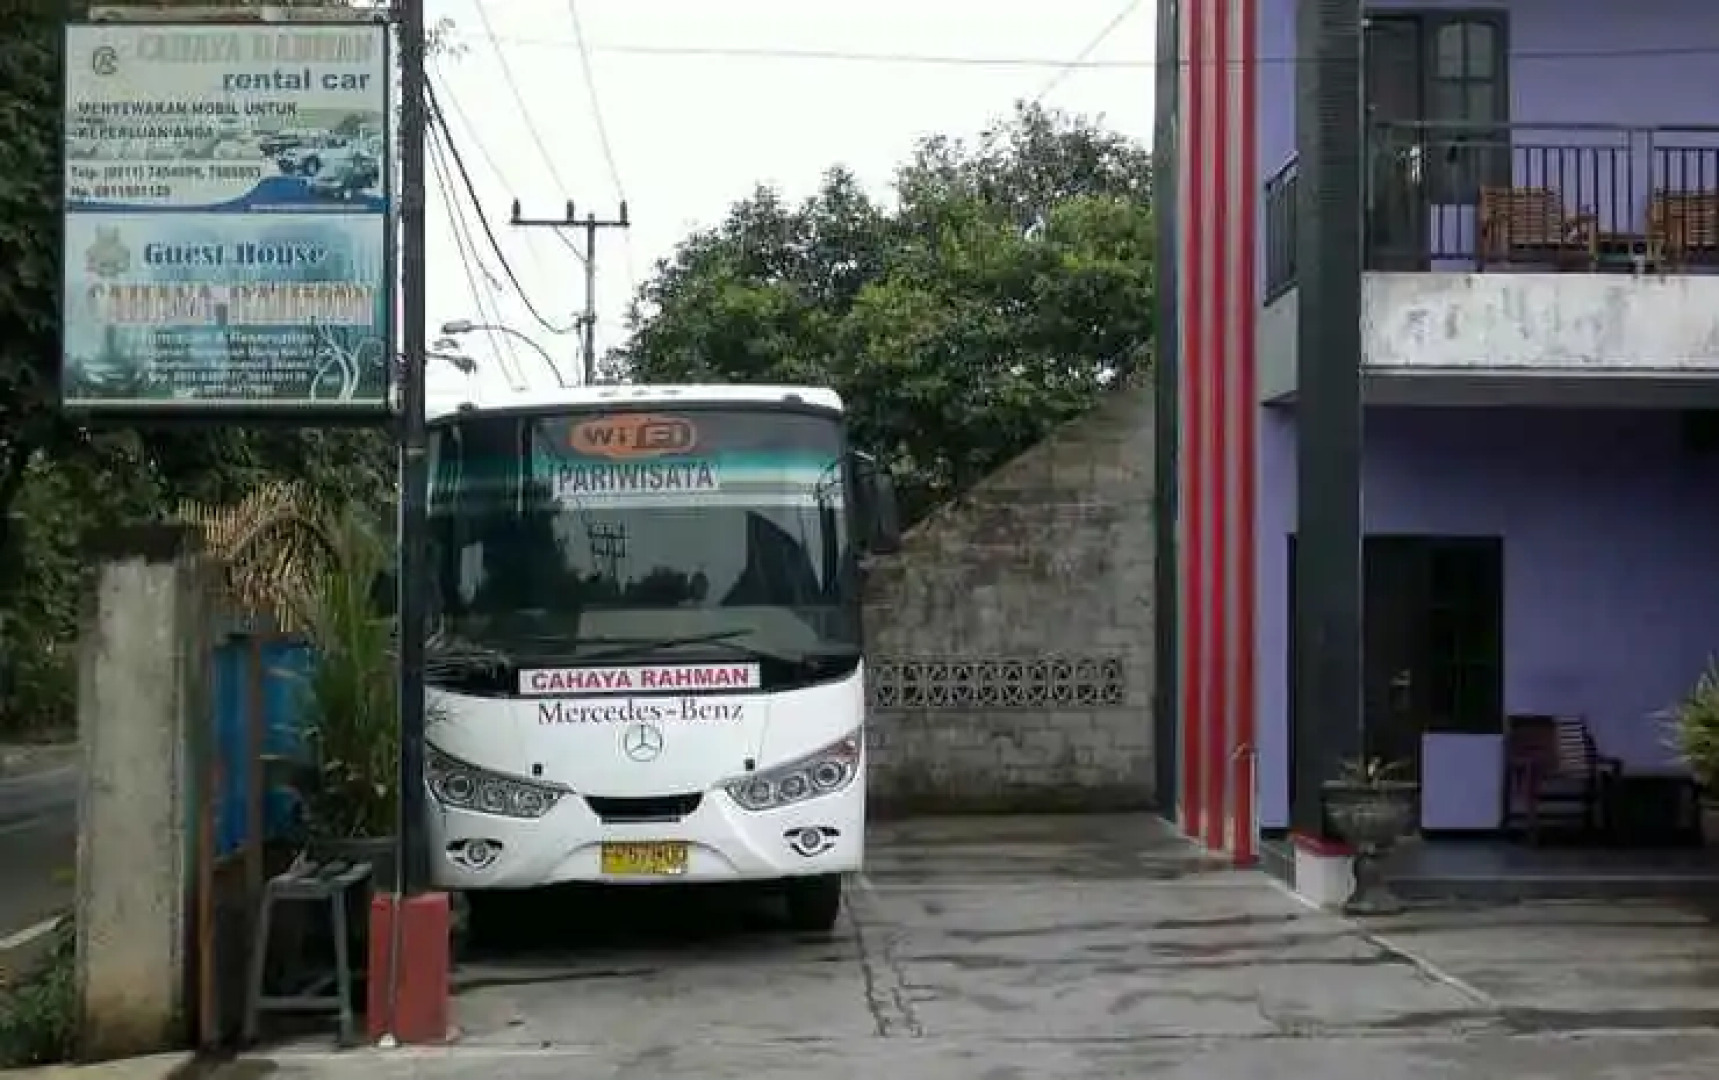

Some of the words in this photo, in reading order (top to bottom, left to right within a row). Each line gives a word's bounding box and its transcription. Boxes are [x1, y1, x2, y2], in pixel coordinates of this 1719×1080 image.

[223, 67, 310, 91] rental
[321, 72, 371, 91] car
[191, 101, 239, 116] MOBIL
[243, 101, 298, 116] UNTUK
[143, 242, 224, 267] Guest
[236, 241, 326, 267] House
[559, 464, 714, 492] PARIWISATA
[531, 670, 632, 691] CAHAYA
[640, 668, 749, 688] RAHMAN
[538, 699, 744, 725] Mercedes-Benz
